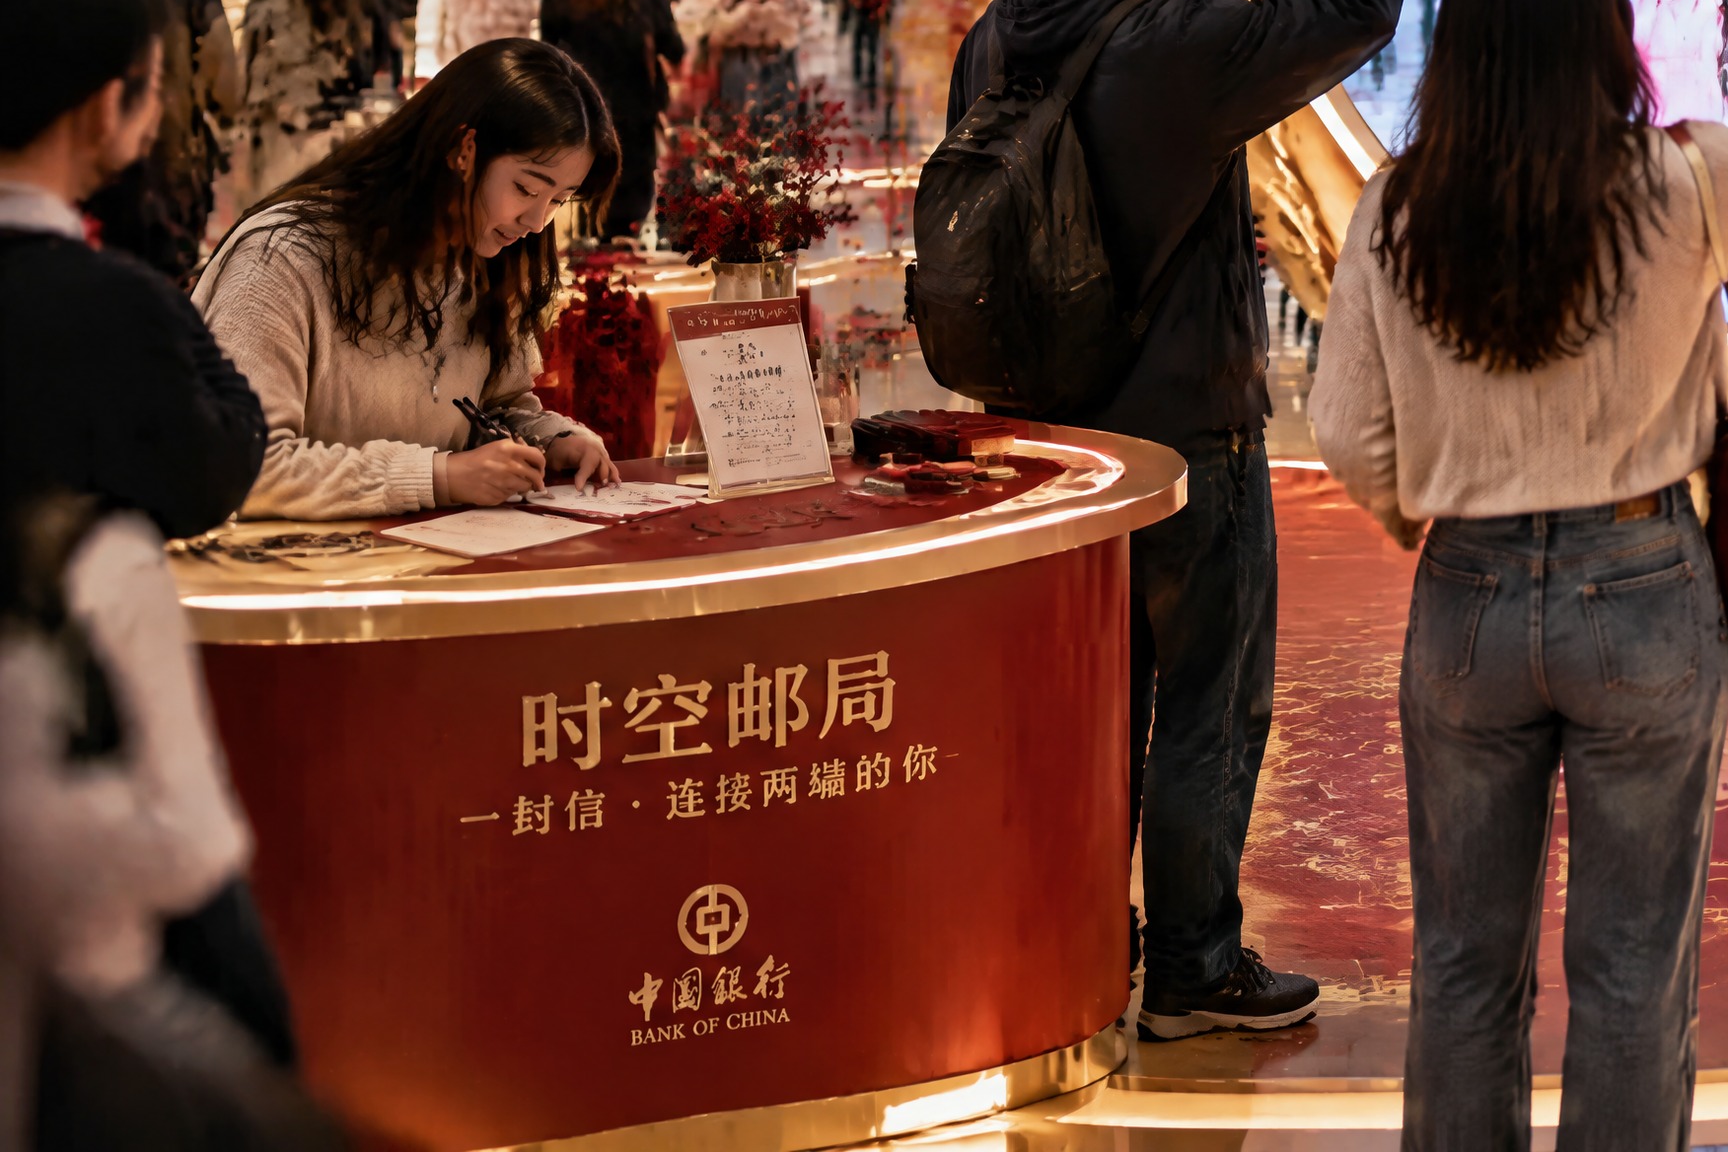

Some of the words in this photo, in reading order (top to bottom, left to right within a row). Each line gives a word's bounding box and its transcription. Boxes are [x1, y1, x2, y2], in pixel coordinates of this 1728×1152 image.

[522, 650, 896, 770] 时空邮局
[631, 1023, 686, 1046] BANK
[693, 1017, 720, 1036] OF
[726, 1008, 791, 1030] CHINA
